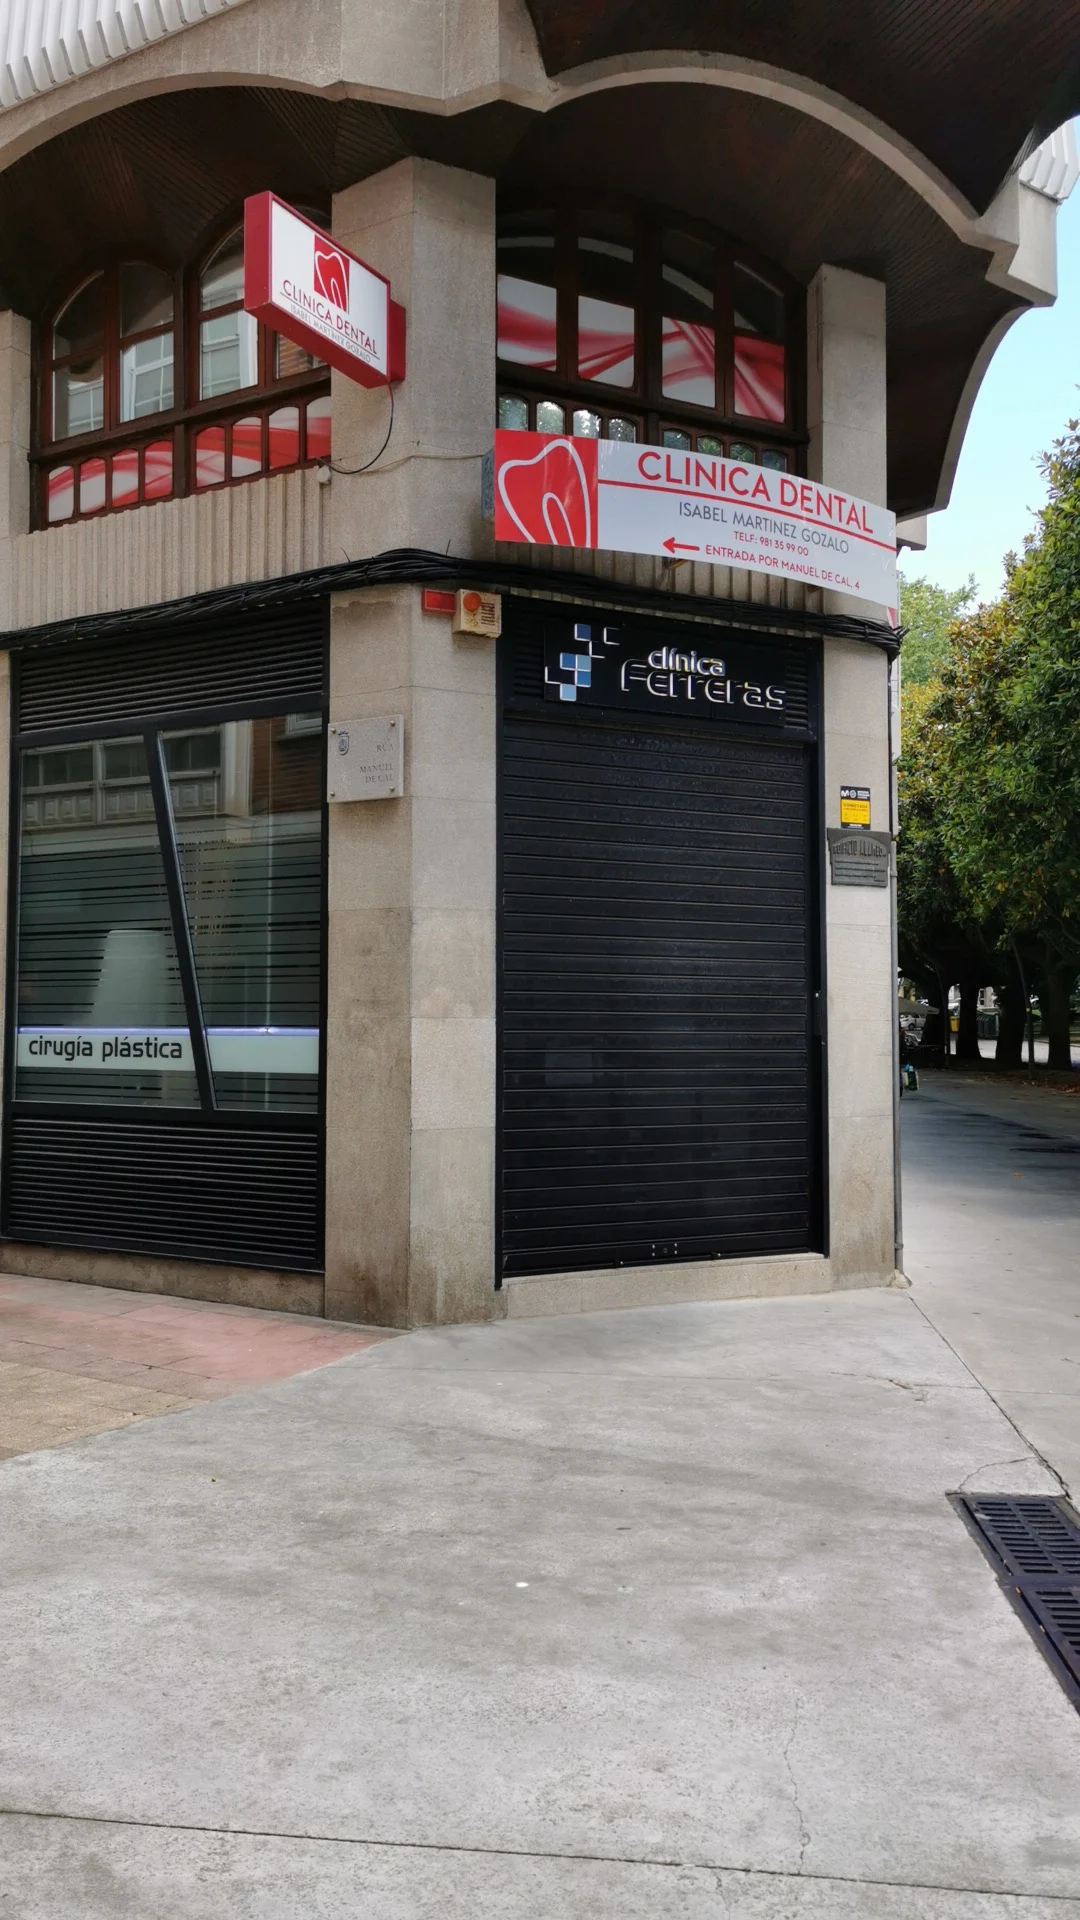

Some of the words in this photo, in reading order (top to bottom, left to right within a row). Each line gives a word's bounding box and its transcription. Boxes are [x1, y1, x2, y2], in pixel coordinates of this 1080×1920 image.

[283, 280, 333, 325] CLINICA
[336, 314, 377, 355] DENTAL
[290, 303, 312, 323] ISABEL
[345, 340, 371, 363] GOZALO
[637, 451, 771, 502] CLINICA
[780, 478, 874, 534] DENTAL
[679, 501, 728, 523] ISABEL
[732, 511, 797, 539] MARTINEZ
[801, 528, 849, 554] GOZALO
[733, 530, 759, 544] TELF:
[759, 536, 773, 548] 981
[774, 539, 785, 550] 35
[785, 541, 796, 553] 99
[797, 545, 809, 557] 00
[705, 544, 756, 563] ENTRADA
[758, 554, 779, 569] POR
[781, 559, 820, 579] MANUEL
[821, 571, 834, 582] DE
[854, 580, 861, 590] 4
[648, 646, 726, 677] clínica
[359, 763, 393, 774] MANUEL
[365, 775, 376, 783] DE
[377, 773, 393, 782] CAL
[28, 1035, 93, 1061] cirugía
[101, 1036, 183, 1062] plástica
